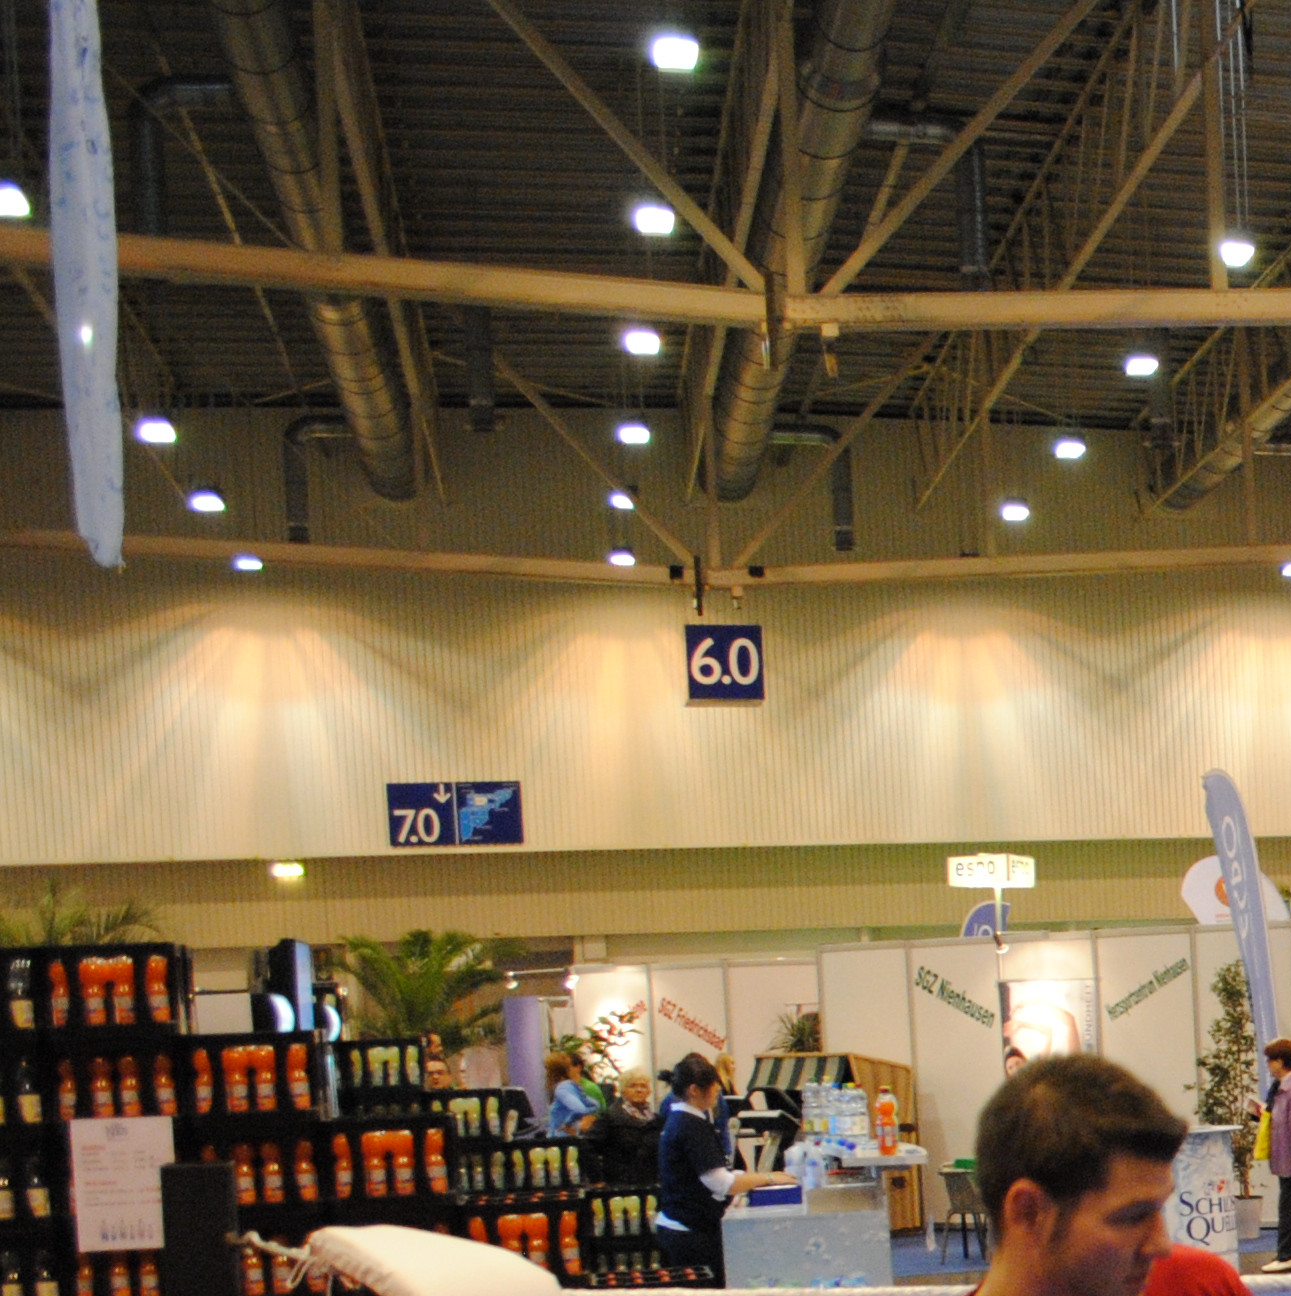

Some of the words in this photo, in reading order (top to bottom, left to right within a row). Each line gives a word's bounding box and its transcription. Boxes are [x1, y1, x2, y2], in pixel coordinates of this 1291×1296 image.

[690, 637, 759, 685] 6.0
[393, 807, 440, 843] 7.0
[658, 997, 678, 1021] SGZ
[915, 965, 939, 995] SGZ
[936, 977, 996, 1029] Nienhausen
